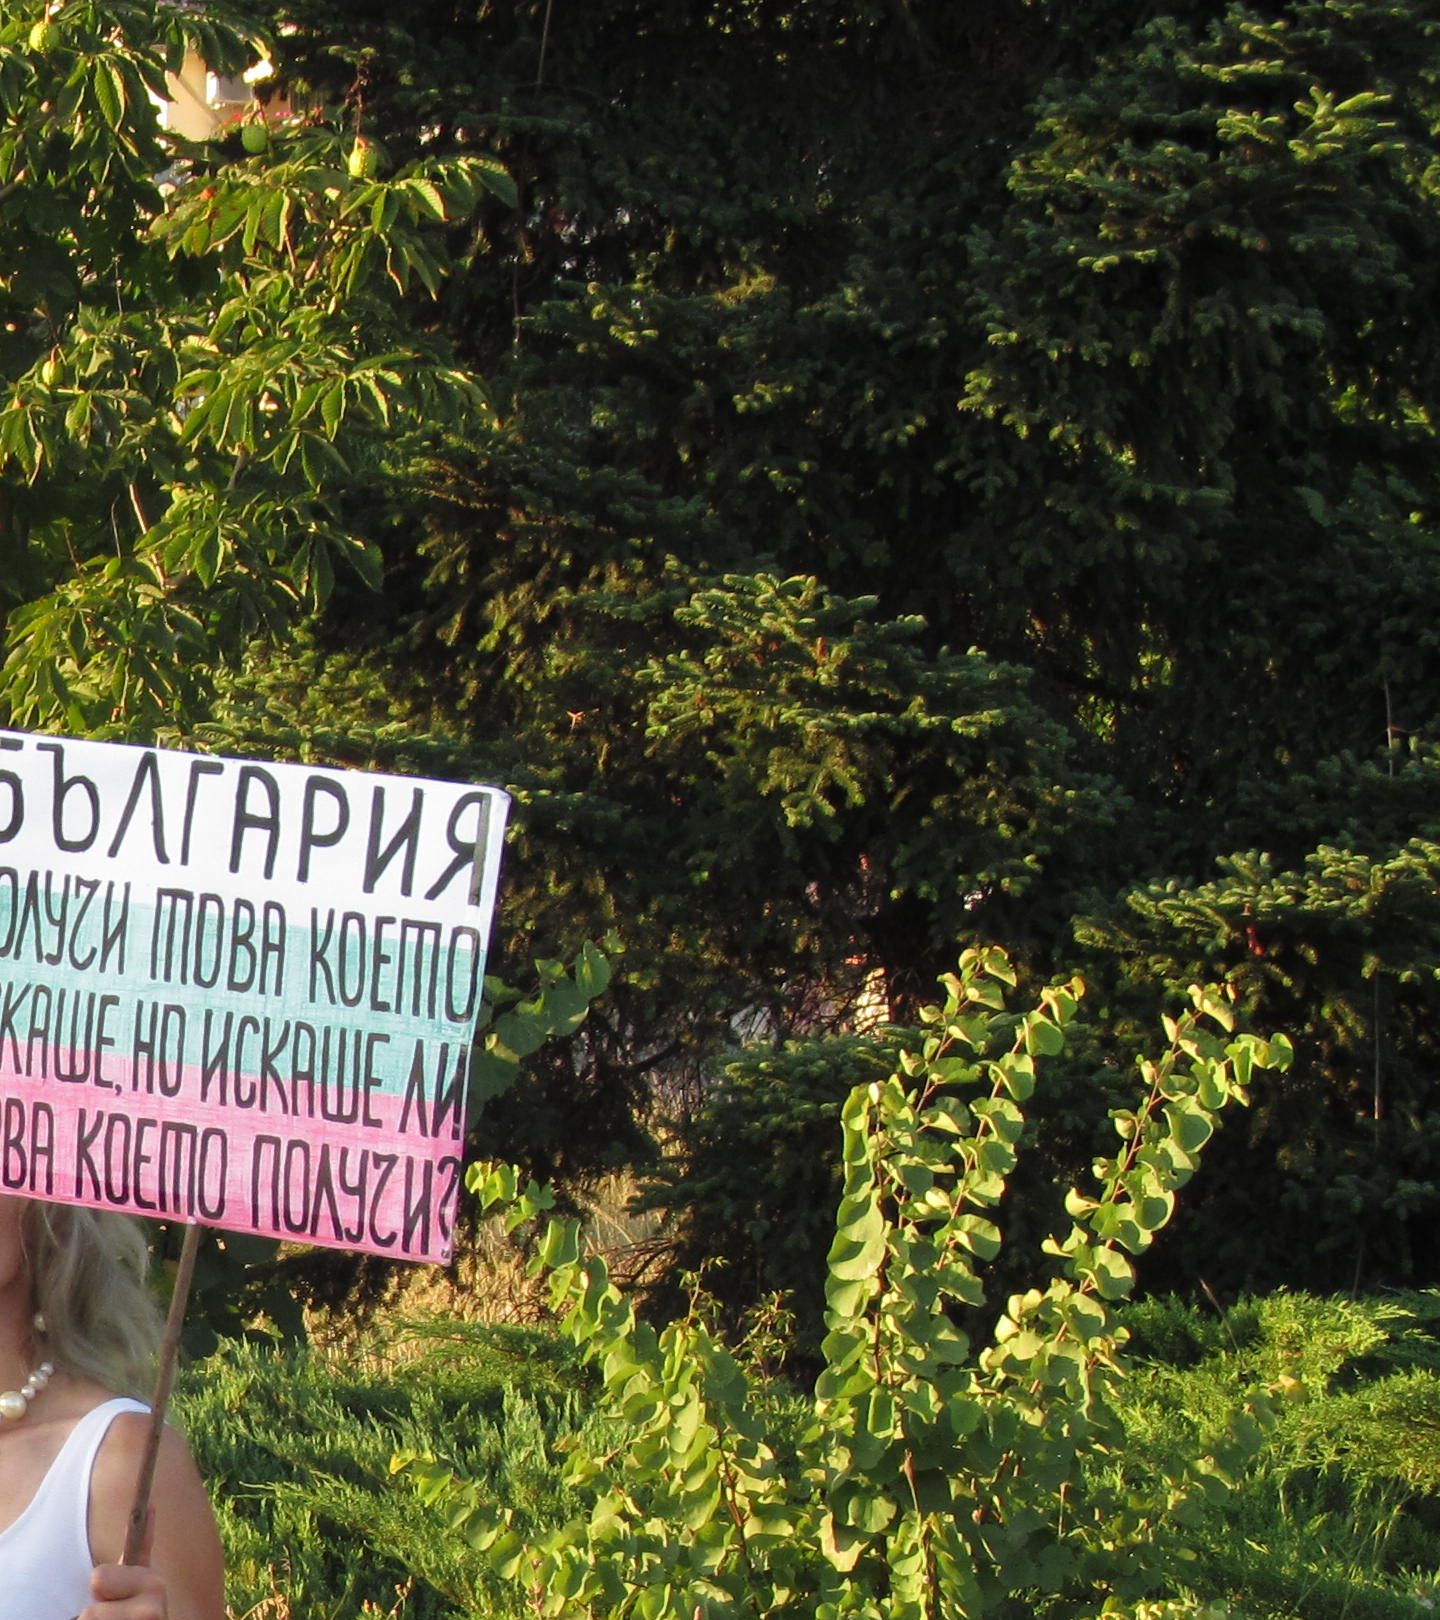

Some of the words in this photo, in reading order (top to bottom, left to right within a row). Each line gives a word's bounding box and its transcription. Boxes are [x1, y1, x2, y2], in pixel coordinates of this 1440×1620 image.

[150, 887, 287, 997] ТОВА
[309, 907, 482, 1024] КОЕТО
[132, 1000, 186, 1098] НО
[200, 1009, 391, 1128] ИСКАШЕ
[399, 1040, 469, 1140] ЛИ
[74, 1108, 229, 1221] КОЕТО
[251, 1134, 462, 1259] ПОЛУЧИ?
